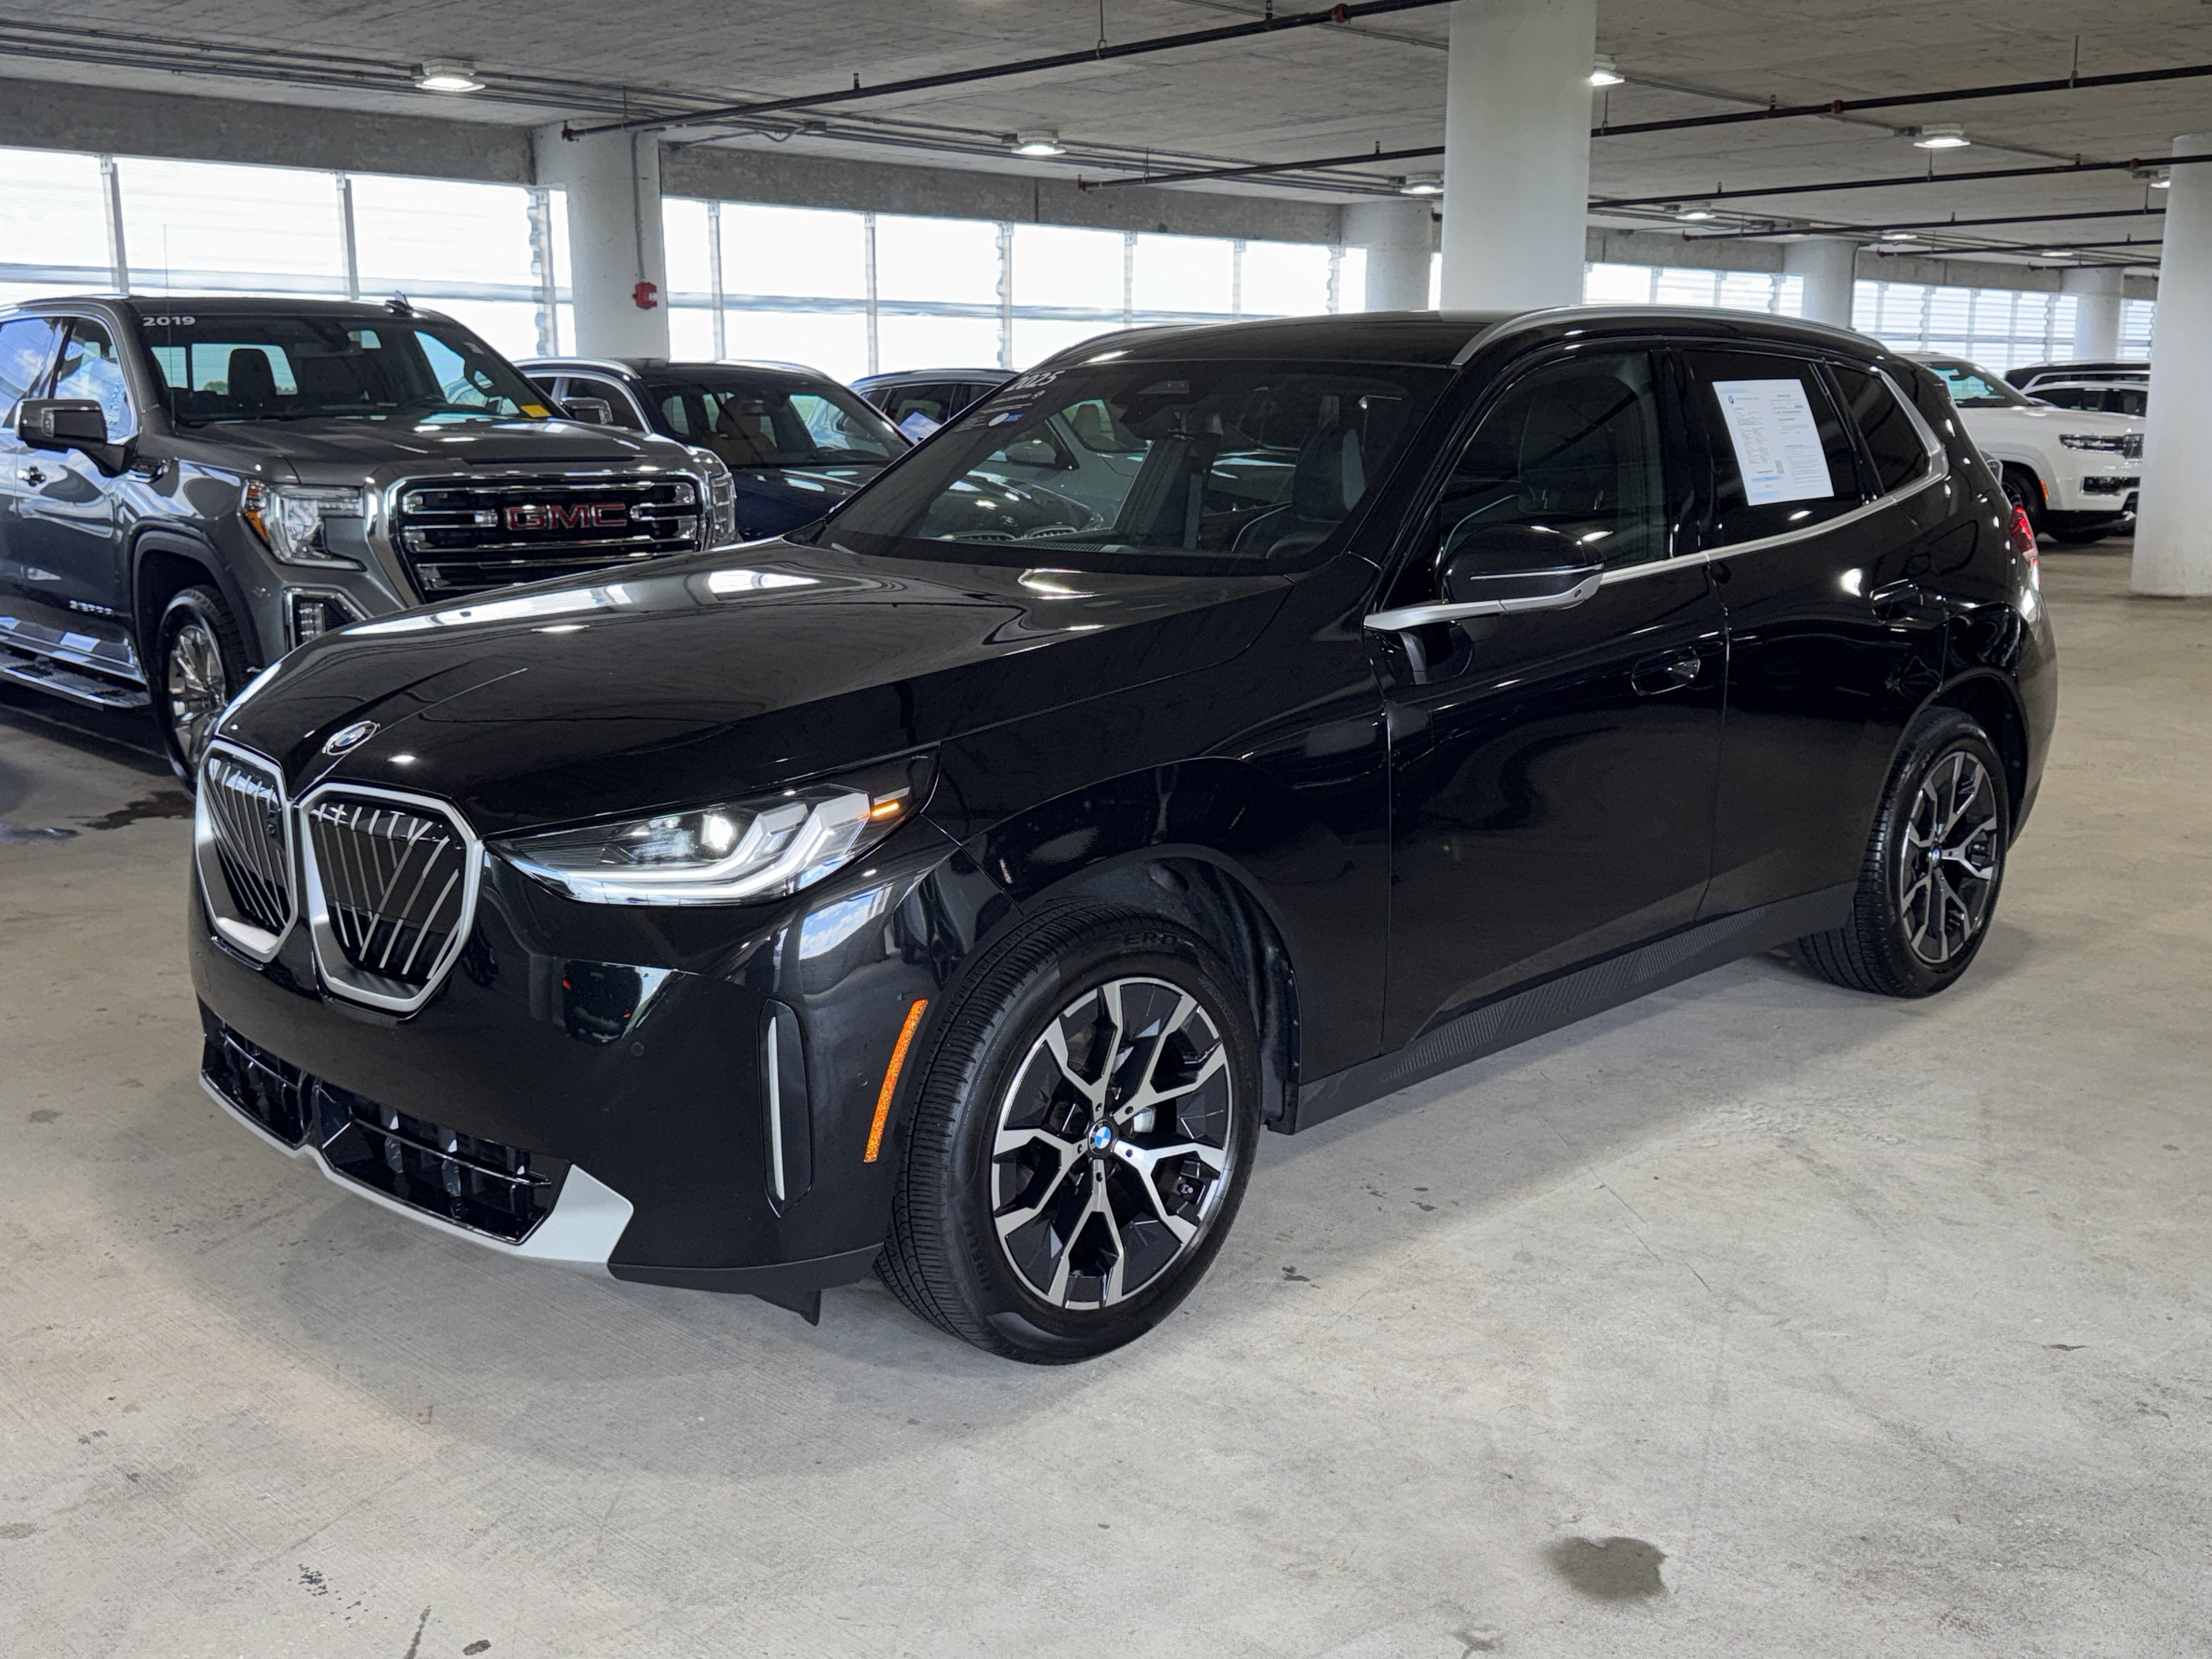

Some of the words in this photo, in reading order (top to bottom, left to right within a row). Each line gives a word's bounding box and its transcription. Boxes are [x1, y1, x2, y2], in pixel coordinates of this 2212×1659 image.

[143, 316, 196, 327] 2019
[1003, 370, 1066, 392] 2025
[505, 503, 627, 531] GMC
